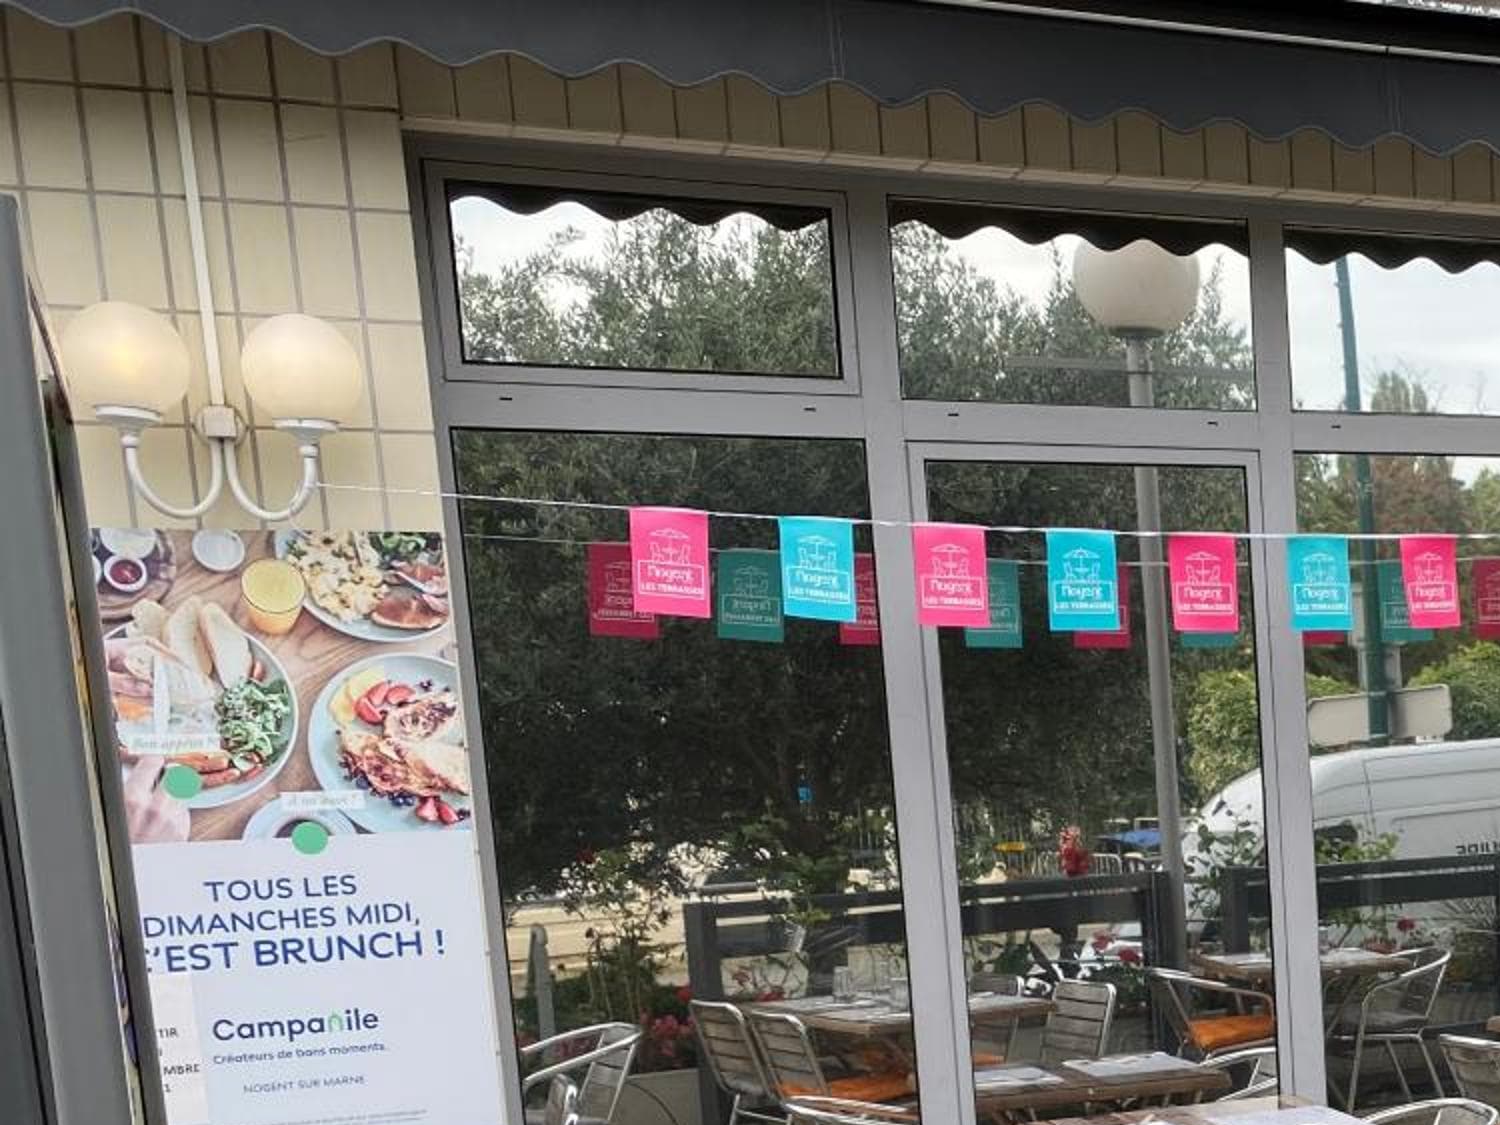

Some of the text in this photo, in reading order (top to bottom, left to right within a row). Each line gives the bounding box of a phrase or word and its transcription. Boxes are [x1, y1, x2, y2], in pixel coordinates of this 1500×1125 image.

[203, 874, 357, 903] TOUS LES
[143, 901, 420, 938] DIMANCHES MIDI,
[254, 931, 424, 967] BRUNCH
[434, 928, 446, 955] !
[212, 1008, 380, 1043] Campanile
[277, 1049, 292, 1060] de
[296, 1046, 326, 1057] bons
